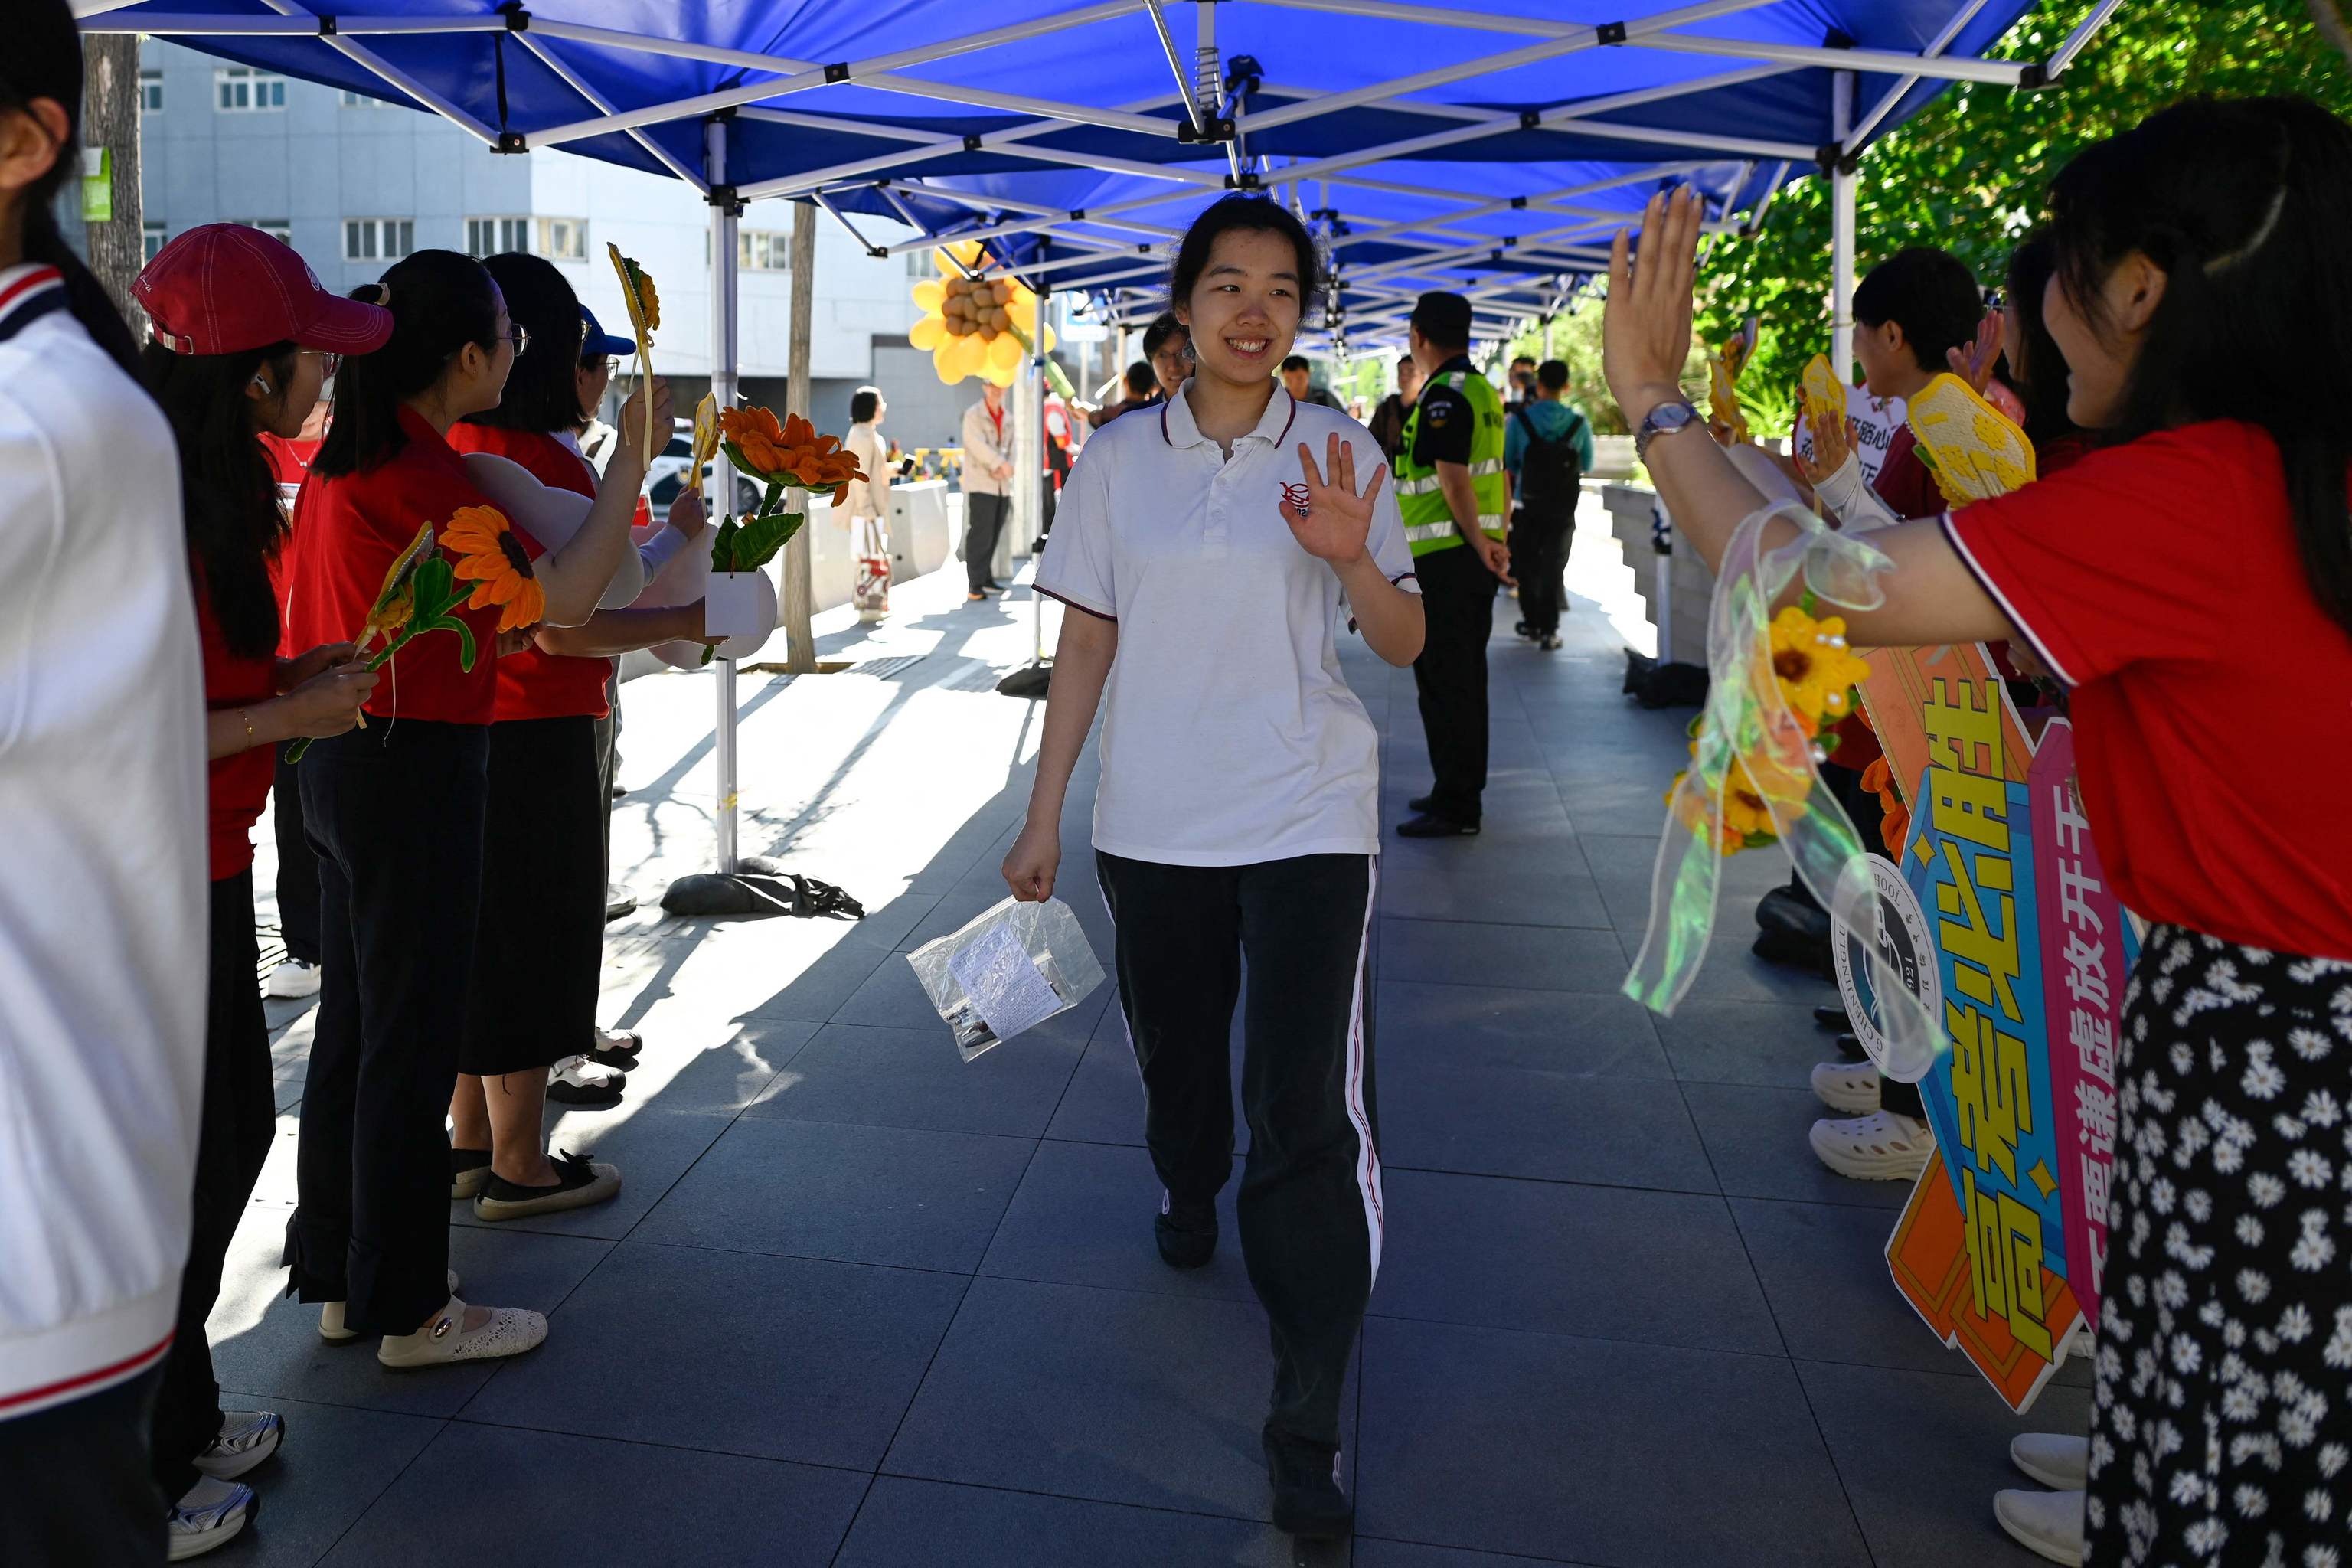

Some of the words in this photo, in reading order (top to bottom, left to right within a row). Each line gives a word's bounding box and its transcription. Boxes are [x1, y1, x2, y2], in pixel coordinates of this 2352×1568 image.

[1839, 924, 1873, 1040] CHENJINGLU
[1922, 676, 2055, 1365] 高考必胜
